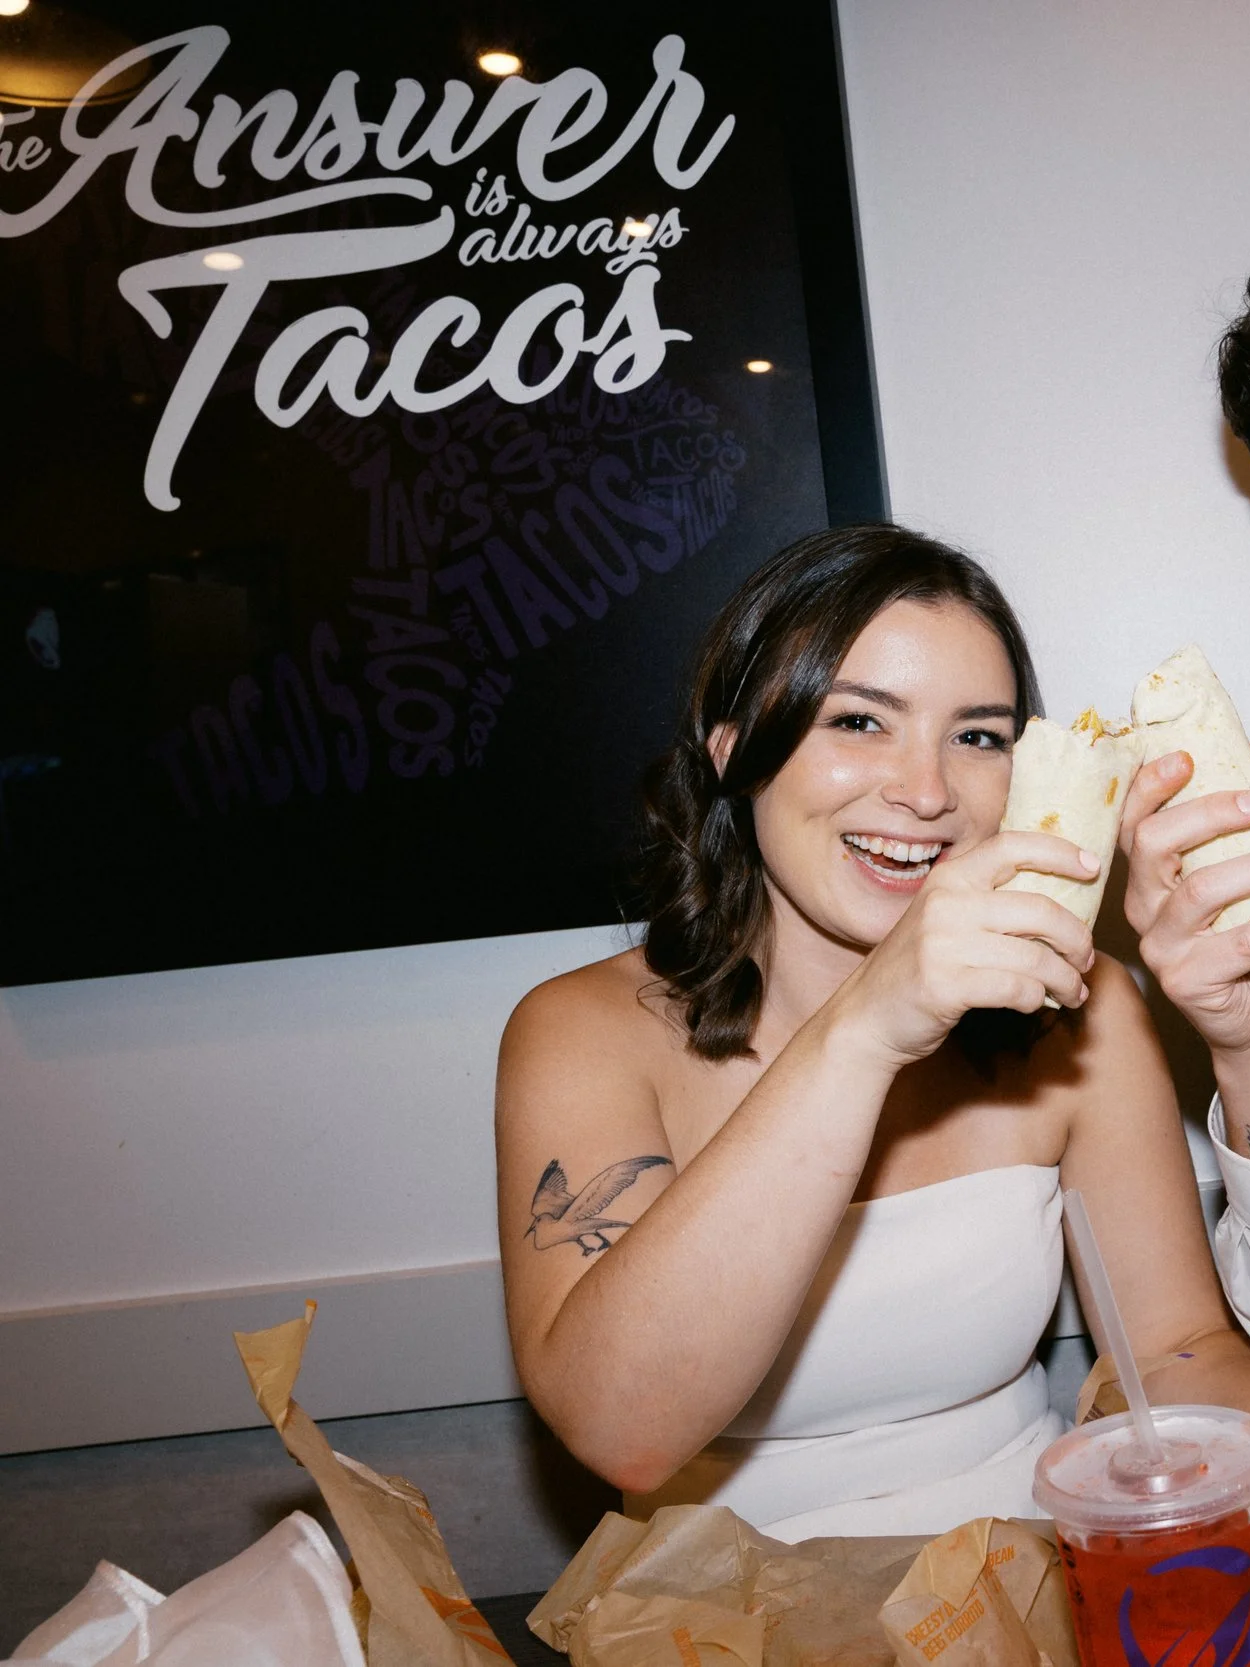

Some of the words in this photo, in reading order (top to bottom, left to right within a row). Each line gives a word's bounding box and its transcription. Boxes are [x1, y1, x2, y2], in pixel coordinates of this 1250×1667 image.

[0, 25, 735, 238] Answer
[466, 168, 515, 217] is
[459, 208, 689, 275] always
[118, 205, 692, 511] Tacos
[432, 454, 683, 660] TACOS
[145, 620, 371, 820] TACOS
[350, 568, 468, 780] TACOS
